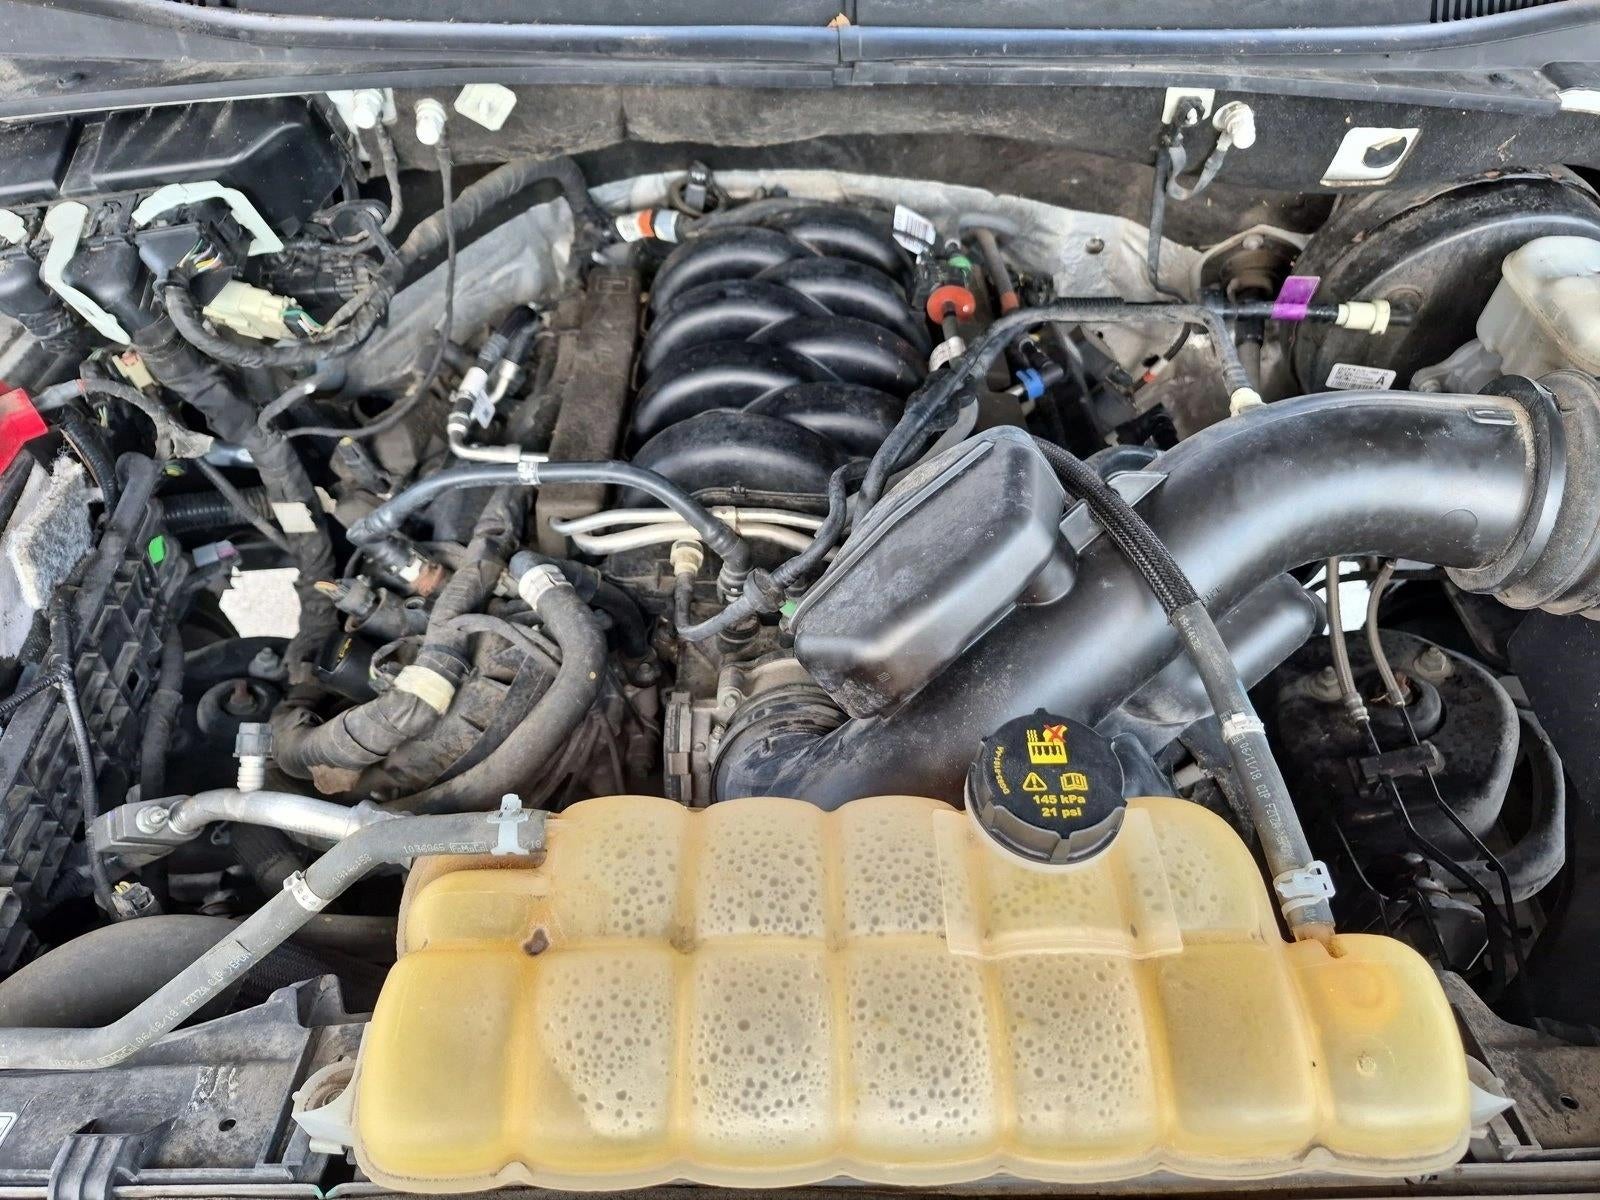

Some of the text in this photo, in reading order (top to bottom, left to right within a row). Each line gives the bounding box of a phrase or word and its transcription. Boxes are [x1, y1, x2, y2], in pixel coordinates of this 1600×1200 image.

[1376, 376, 1385, 385] A
[1033, 795, 1086, 805] 145 kPa
[1042, 807, 1081, 819] 21 psi
